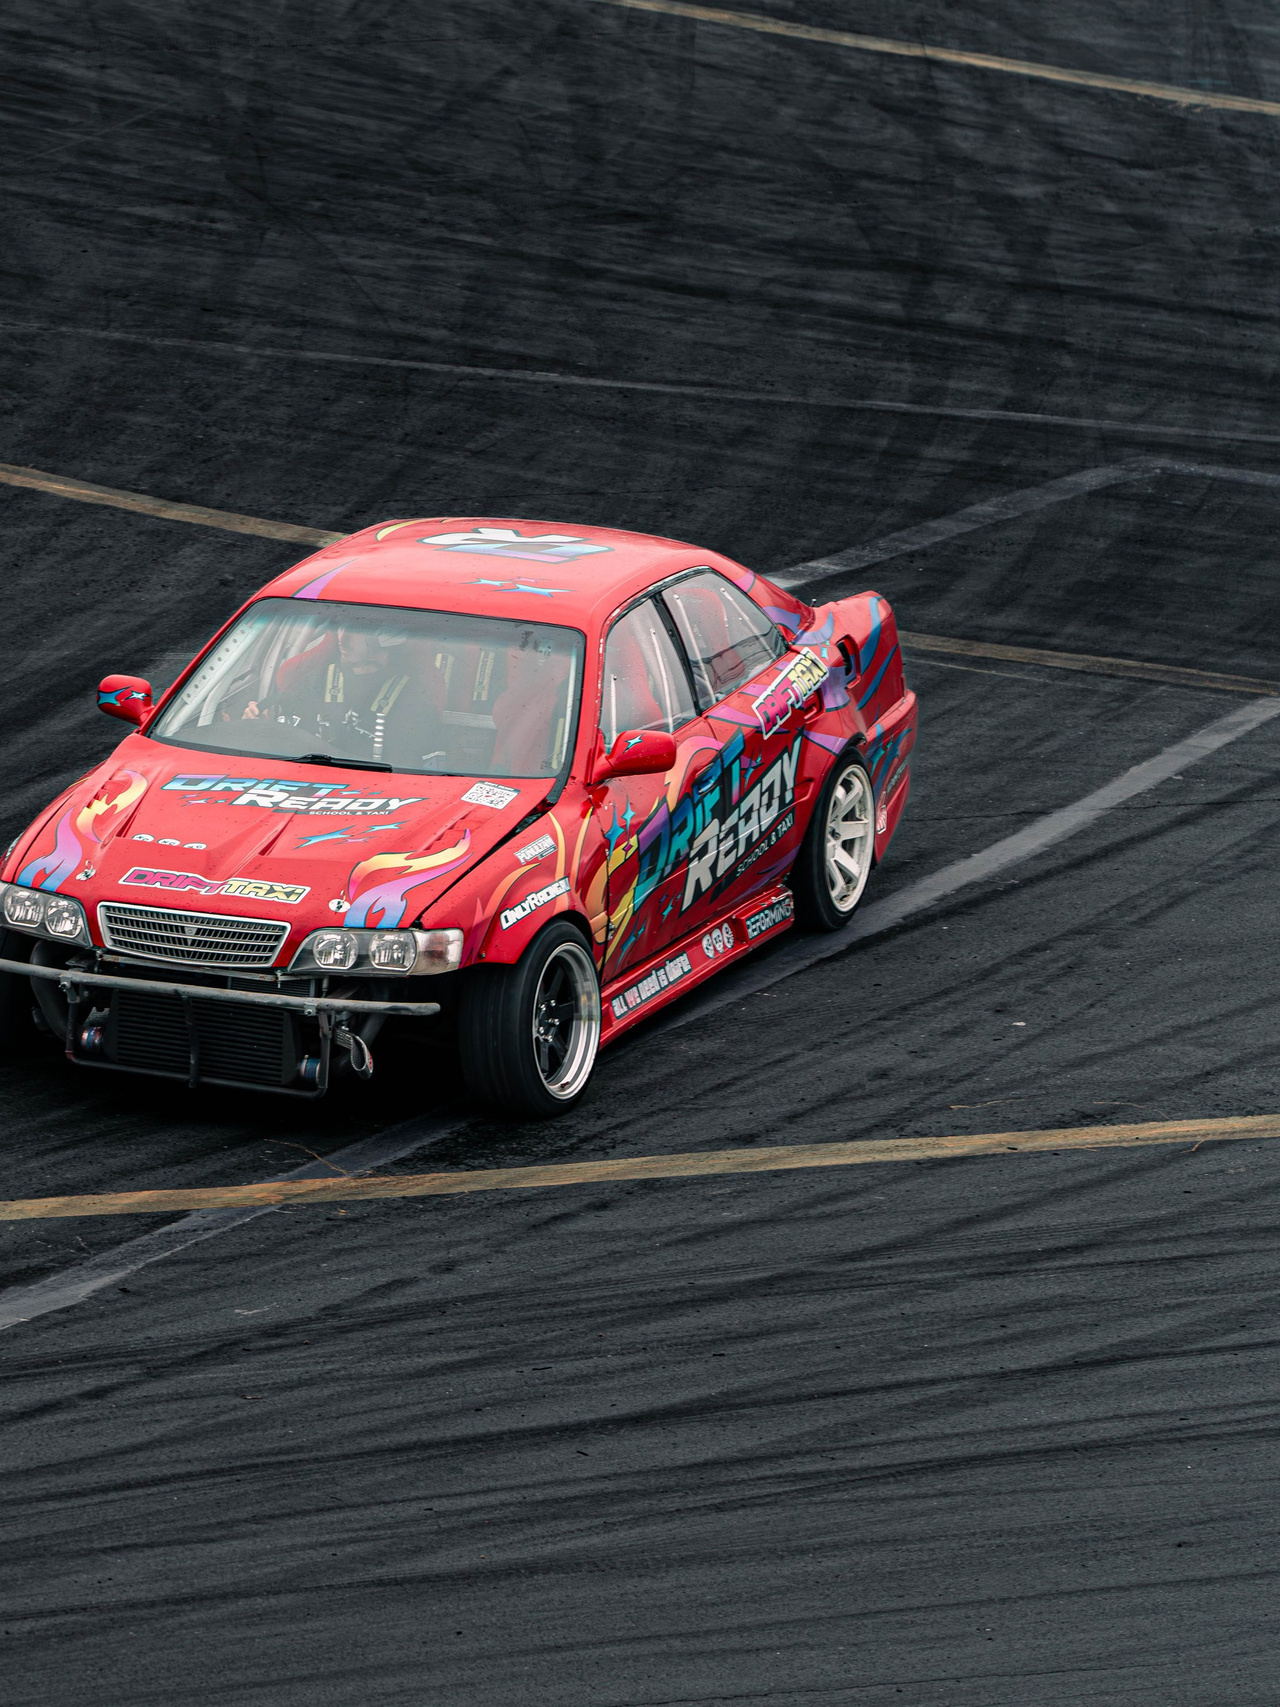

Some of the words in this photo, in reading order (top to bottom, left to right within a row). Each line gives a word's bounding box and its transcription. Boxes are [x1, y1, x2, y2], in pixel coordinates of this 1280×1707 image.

[756, 677, 800, 734] DRIFT
[162, 774, 350, 798] DRIFT
[231, 789, 425, 810] READY
[634, 729, 744, 913] DRIFT
[682, 732, 803, 912] READY
[736, 839, 769, 877] SCHOOL
[770, 831, 777, 845] &
[777, 812, 794, 838] TAXI
[122, 868, 226, 894] DRIFT
[637, 969, 661, 1001] need
